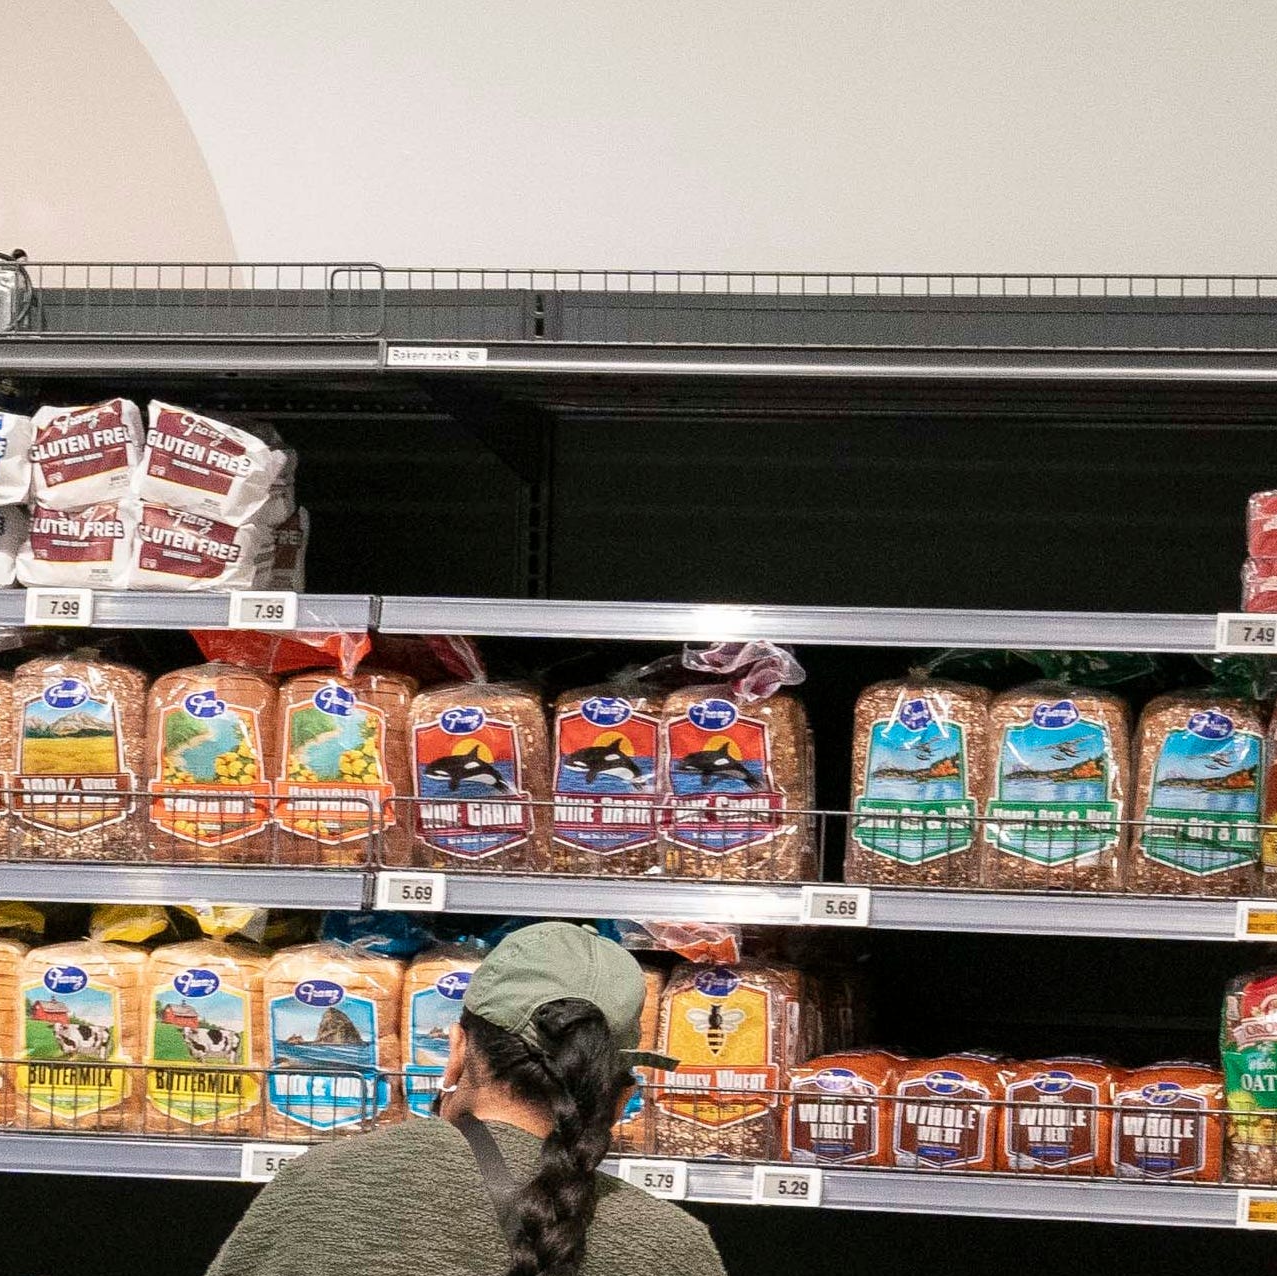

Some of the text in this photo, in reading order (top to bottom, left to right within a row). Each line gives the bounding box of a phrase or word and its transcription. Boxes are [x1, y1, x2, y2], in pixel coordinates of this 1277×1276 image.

[50, 600, 80, 616] 7.99
[254, 604, 284, 620] 7.99
[1243, 627, 1275, 643] 7.49
[401, 885, 433, 901] 5.69
[824, 898, 857, 916] 5.69
[644, 1172, 675, 1189] 5.79
[778, 1180, 809, 1196] 5.29
